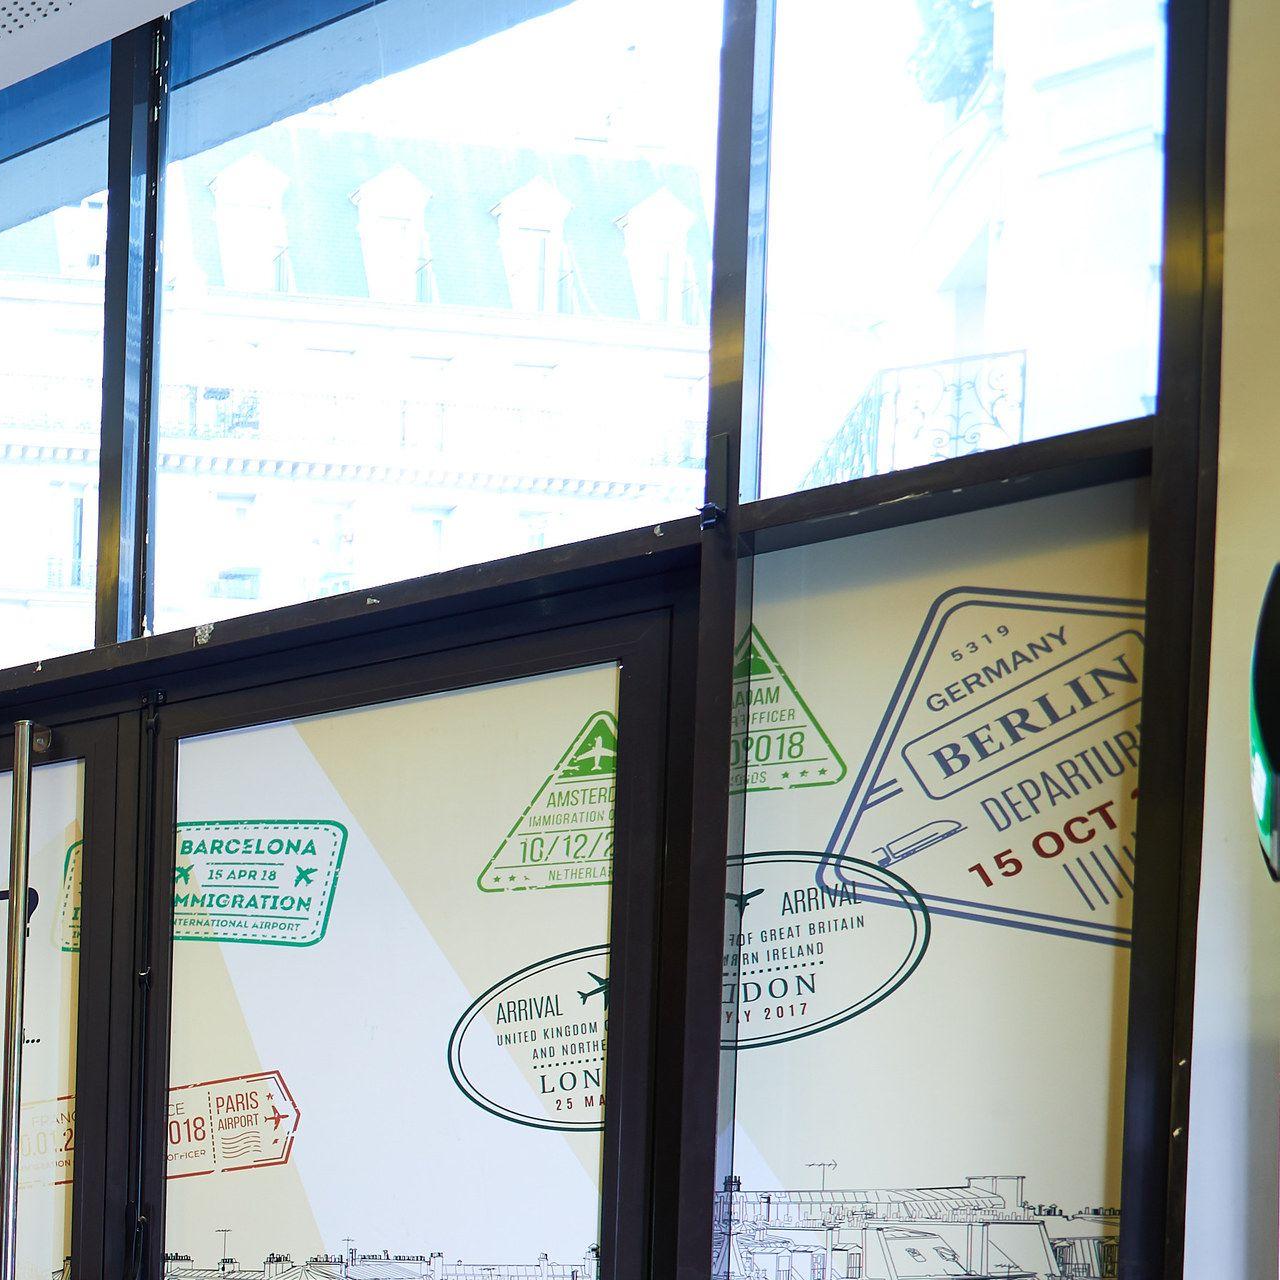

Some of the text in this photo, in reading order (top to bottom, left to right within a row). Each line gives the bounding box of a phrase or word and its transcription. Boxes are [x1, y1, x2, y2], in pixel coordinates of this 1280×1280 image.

[925, 625, 1069, 713] GERMANY
[749, 709, 795, 724] FFICER
[928, 653, 1140, 780] BERLIN
[979, 722, 1140, 833] DEPARTUR
[529, 810, 605, 828] IMMIGRATION
[180, 838, 317, 856] BARCELONA
[967, 800, 1119, 889] 15 OCT
[207, 869, 277, 881] 15 APR 18
[781, 880, 862, 916] ARRIVAL
[251, 921, 301, 932] AIRPORT
[760, 925, 801, 943] GREAT
[809, 915, 865, 936] BRITAIN
[767, 941, 824, 962] IRELAND
[496, 994, 564, 1025] ARRIVAL
[764, 1002, 808, 1020] 2017
[496, 1029, 537, 1046] UNITED
[543, 1021, 598, 1040] KINGDOM
[532, 1045, 555, 1060] AND
[540, 1068, 601, 1094] LON
[215, 1091, 259, 1115] PARIS
[555, 1098, 573, 1111] 25
[217, 1113, 259, 1131] AIRPORT
